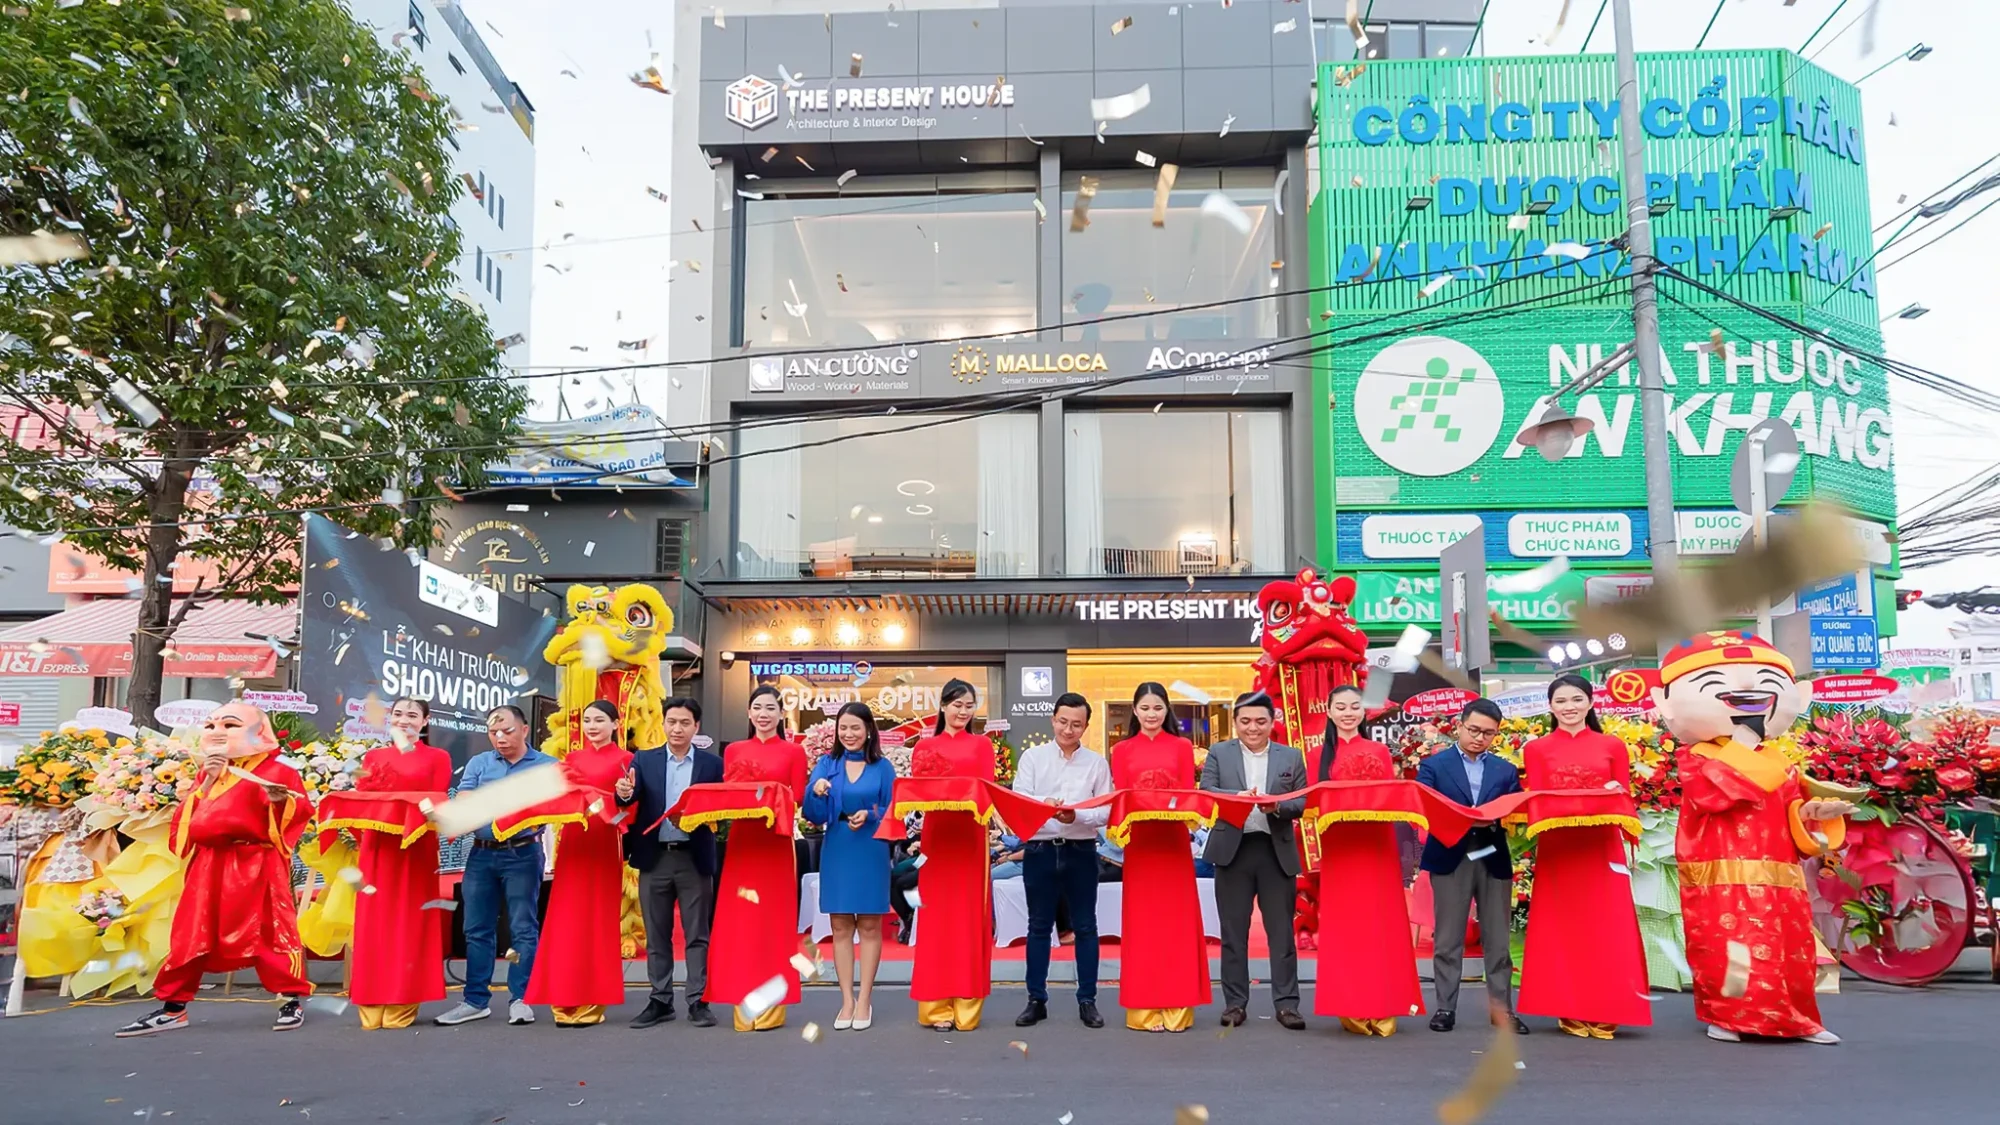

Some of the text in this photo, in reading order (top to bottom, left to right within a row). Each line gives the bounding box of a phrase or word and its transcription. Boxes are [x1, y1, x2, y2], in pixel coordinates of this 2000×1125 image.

[786, 84, 1014, 111] THE PRESENT HOUSE
[786, 115, 937, 129] Architecture & Interior Design
[1352, 75, 1862, 165] CÔNG TY CỔ PHẦN
[1439, 148, 1813, 227] DƯỢC PHẨM
[1335, 234, 1875, 299] AN KHANG PHARMA
[786, 351, 909, 377] AN CƯỜNG
[960, 355, 980, 373] M
[996, 353, 1108, 373] MALLOCA
[1146, 346, 1270, 374] AConcept
[787, 381, 815, 391] Wood
[866, 380, 909, 390] Materials
[1001, 376, 1025, 385] Smart
[1027, 375, 1058, 385] Kitchen
[1066, 375, 1090, 384] Smart
[1664, 390, 1893, 472] KHANG
[608, 458, 636, 473] CAO
[1395, 577, 1434, 595] AN
[1364, 595, 1435, 620] LUÔN
[1833, 587, 1857, 610] CHÂU
[1075, 600, 1119, 620] THE
[1123, 599, 1228, 620] PRESENT
[1811, 631, 1874, 653] ÍCH QUẢNG ĐỨC
[185, 651, 258, 662] Online Business
[412, 638, 454, 671] KHAI
[42, 663, 90, 674] EXPRESS
[751, 664, 854, 676] VICOSTONE
[781, 686, 861, 711] GRAND
[1011, 700, 1056, 712] AN CƯỜN
[459, 720, 488, 734] 19-05-2023
